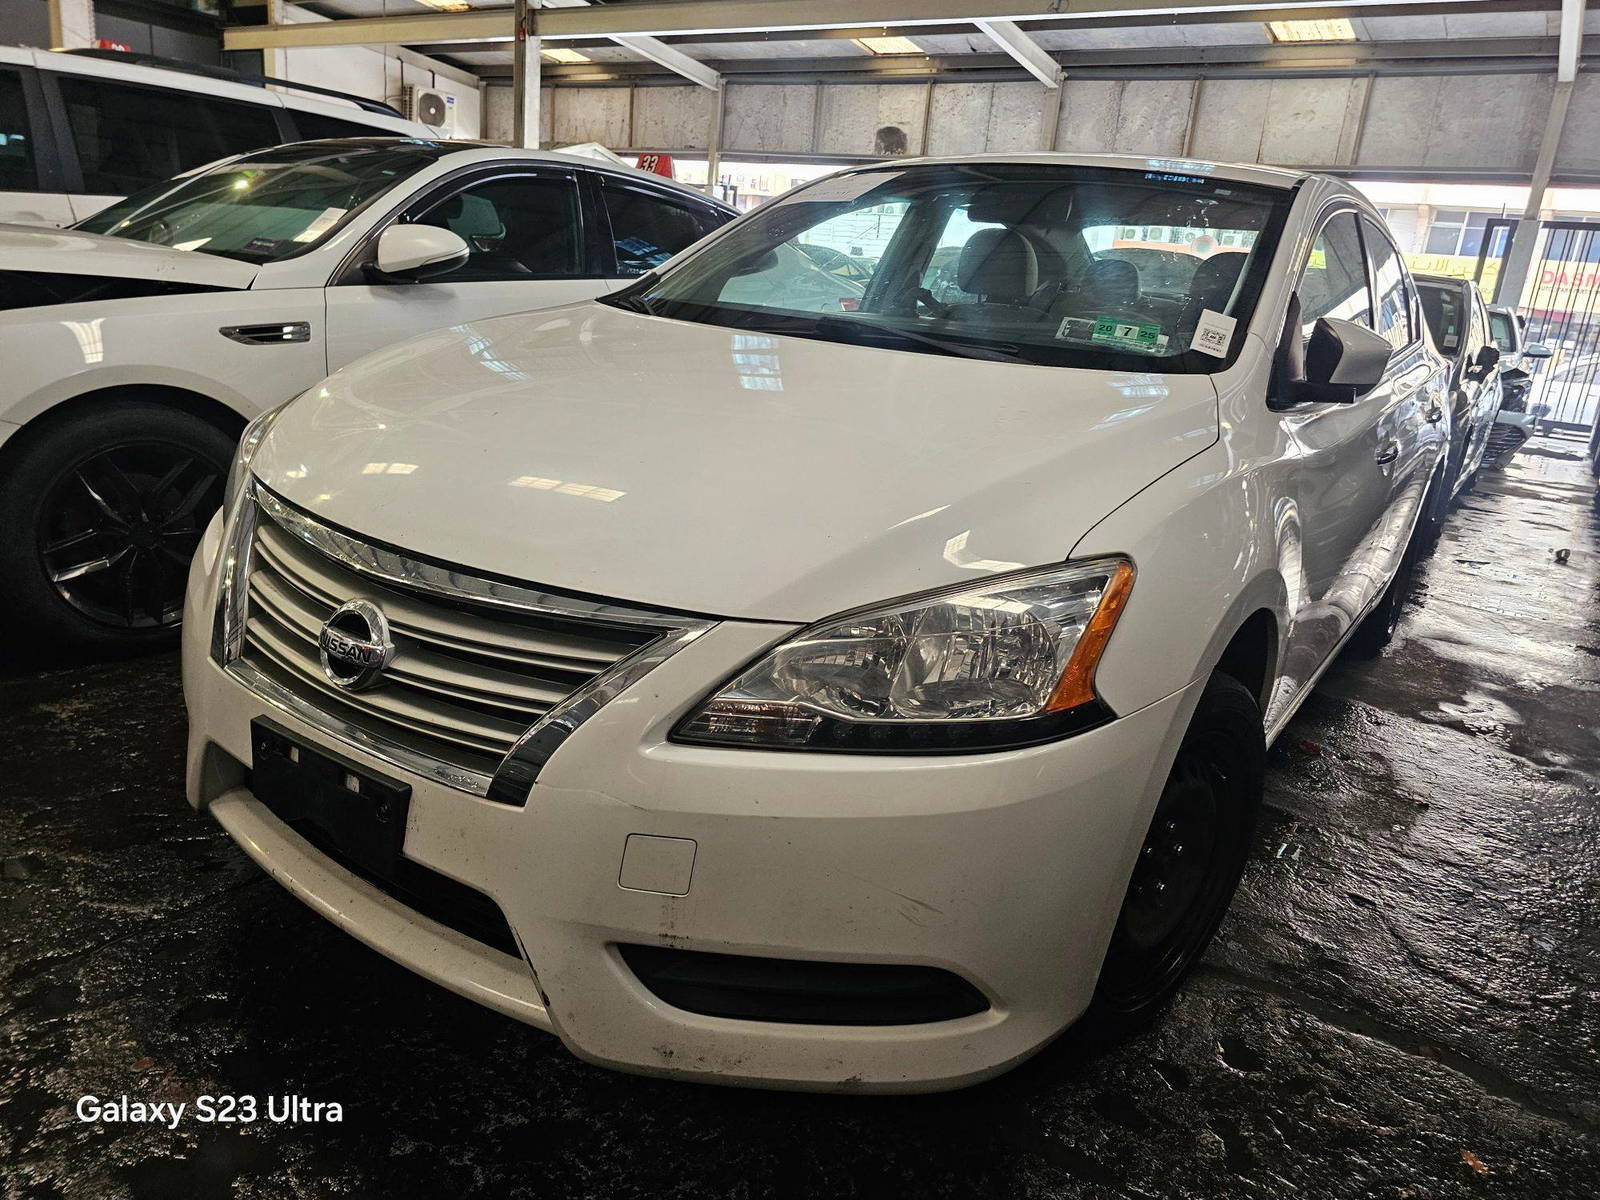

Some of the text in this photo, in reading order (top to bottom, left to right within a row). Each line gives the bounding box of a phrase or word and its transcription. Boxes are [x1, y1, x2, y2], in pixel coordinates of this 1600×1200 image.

[641, 155, 659, 173] 33
[1099, 324, 1156, 340] 20 7 25
[320, 631, 371, 664] NISSAN
